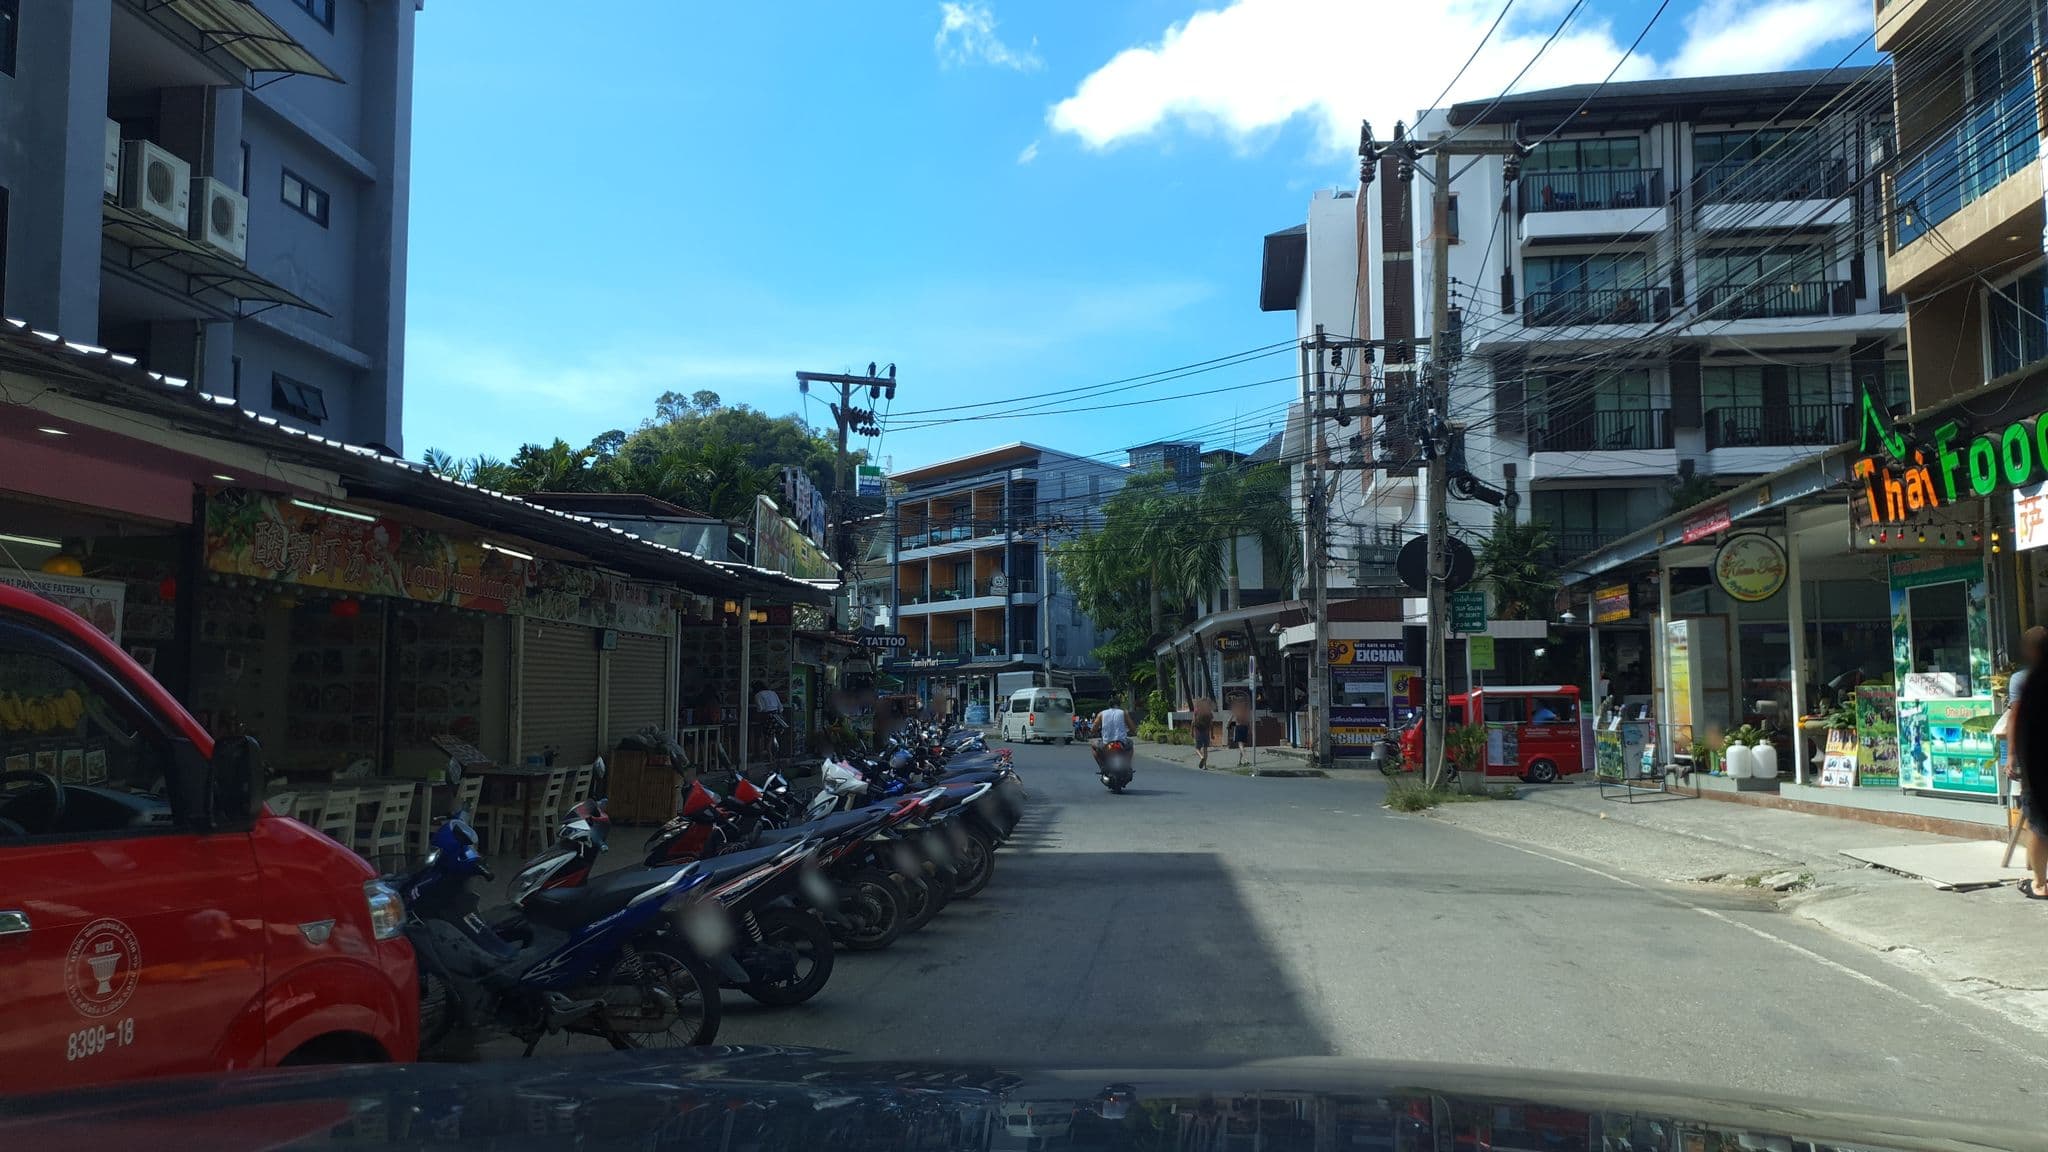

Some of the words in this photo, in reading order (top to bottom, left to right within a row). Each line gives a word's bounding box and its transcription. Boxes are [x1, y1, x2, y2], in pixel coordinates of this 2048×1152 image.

[1853, 449, 1939, 523] Thai
[1934, 411, 2048, 501] Foo
[53, 583, 85, 594] FATEEMA
[866, 637, 905, 646] TATTOO
[1356, 649, 1404, 662] EXCHAN
[911, 658, 939, 667] FamilyMart
[67, 1017, 134, 1061] 8399-18
